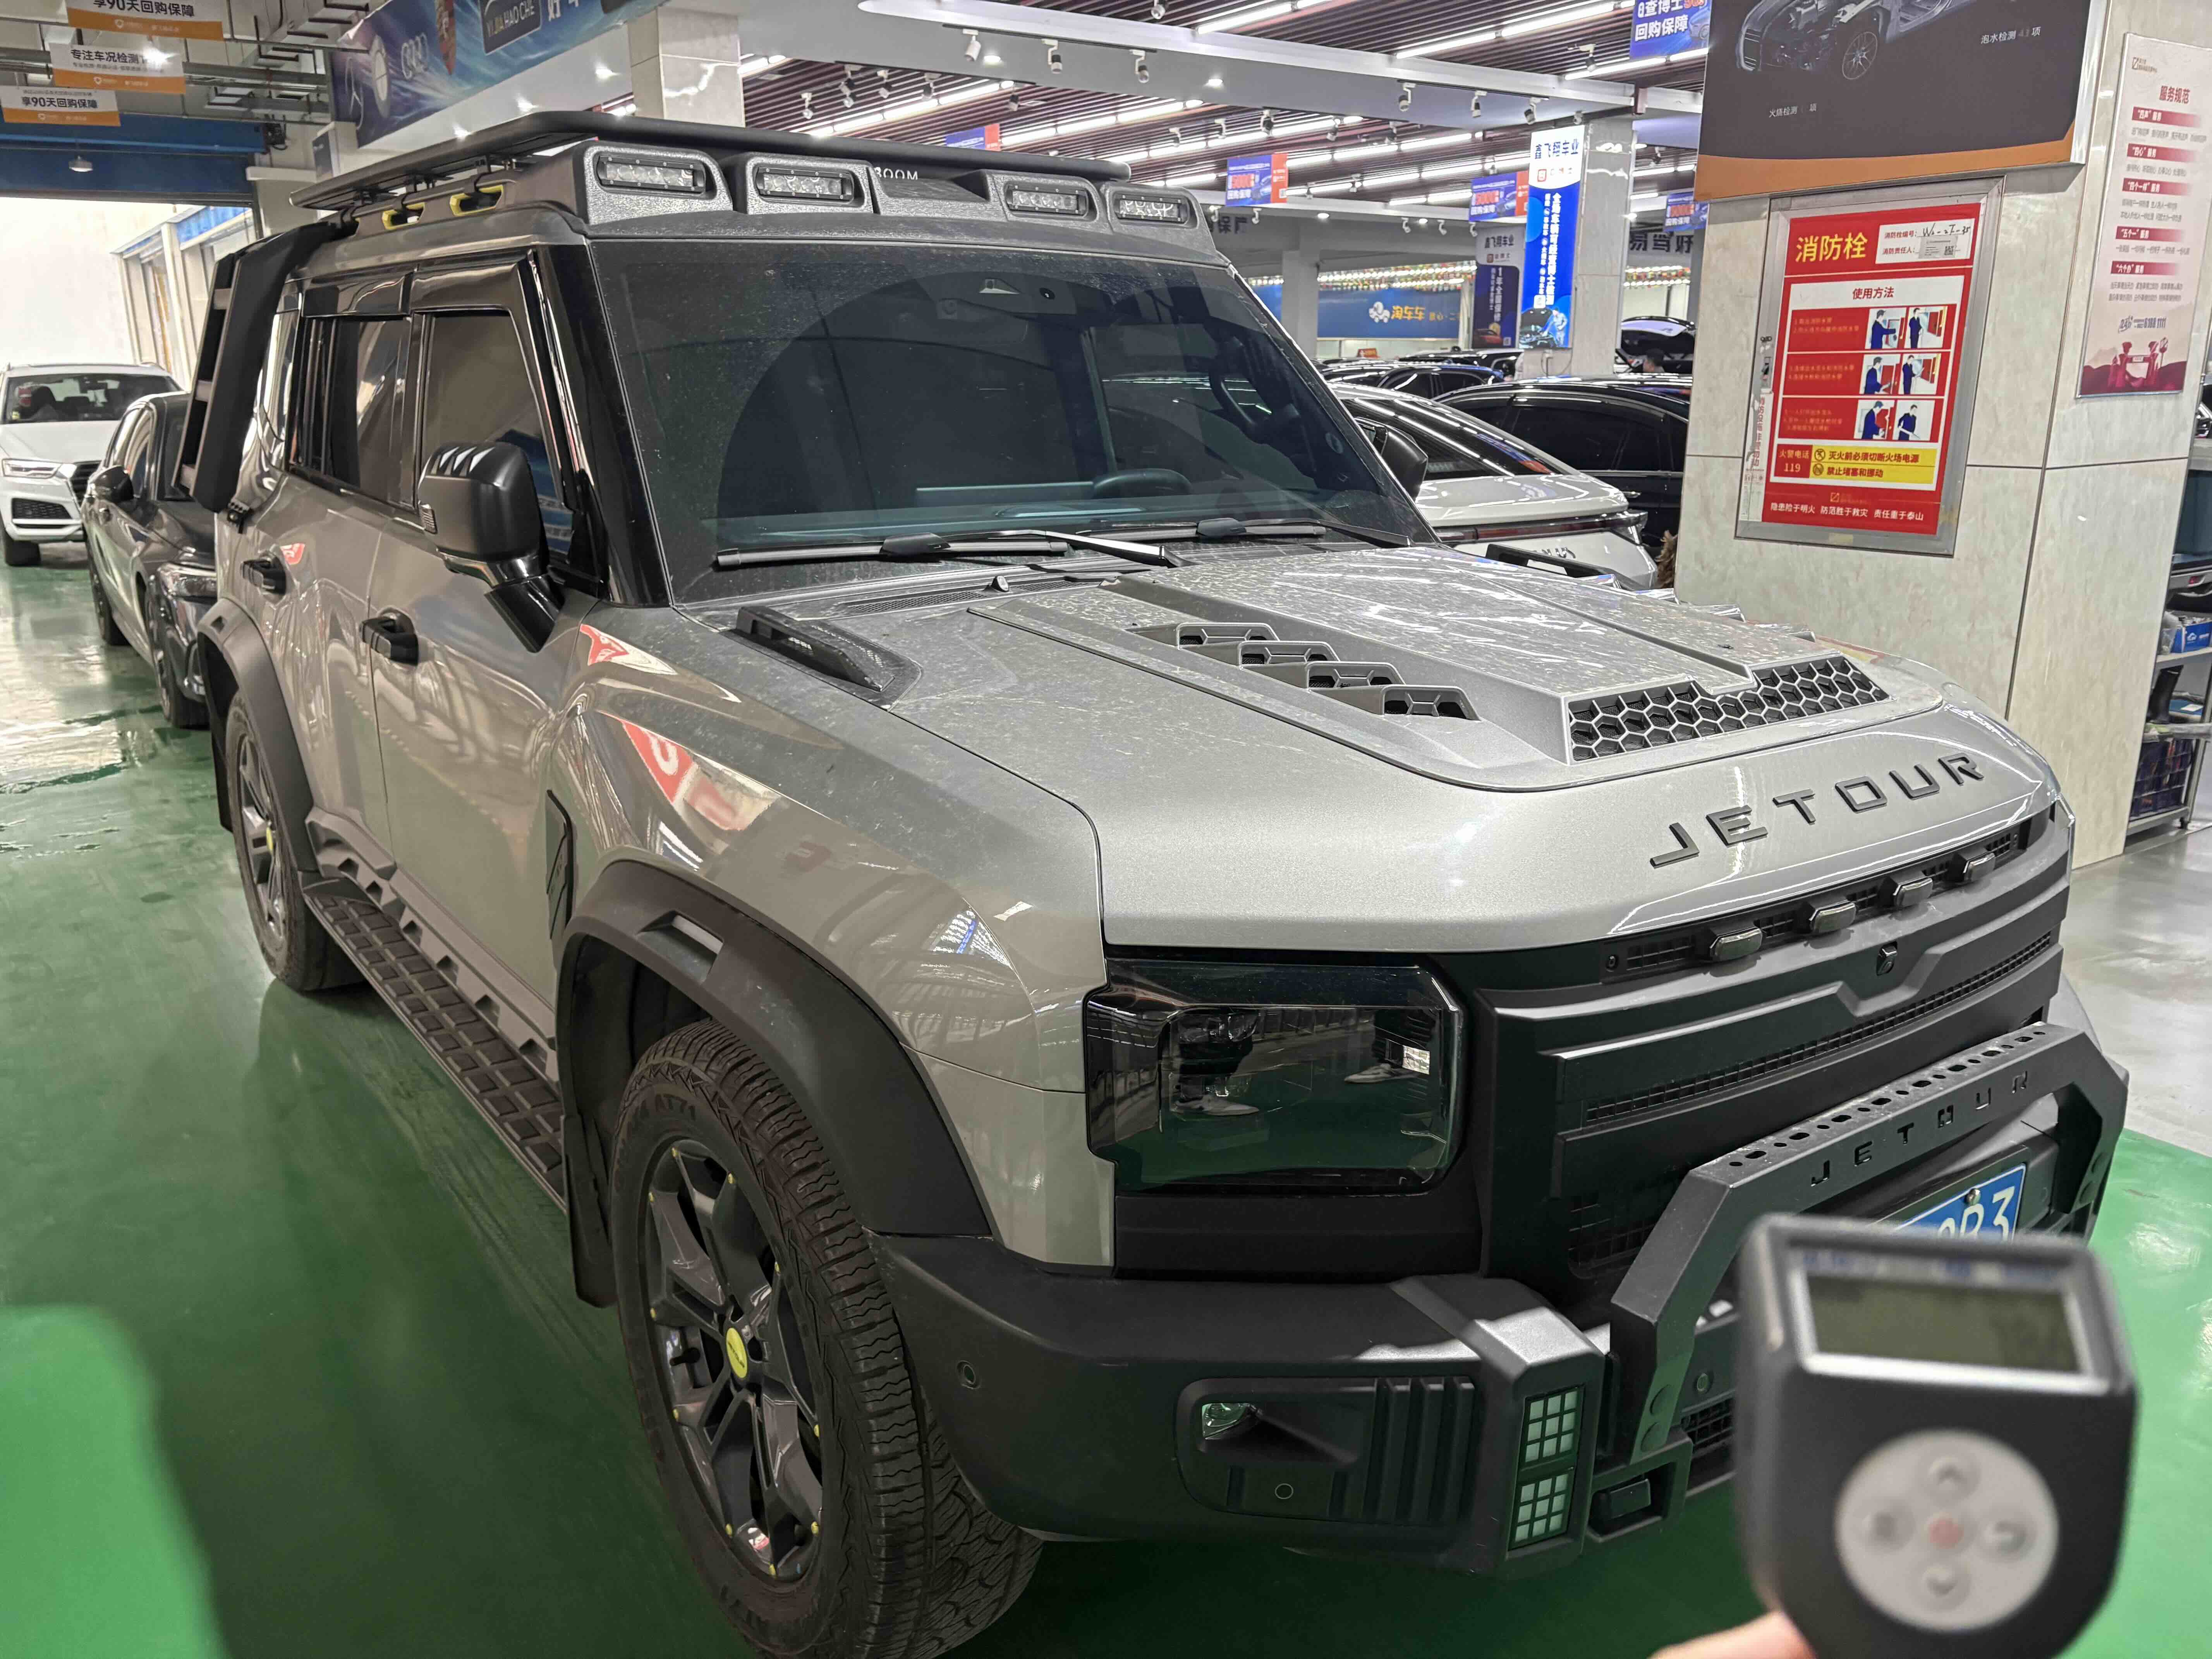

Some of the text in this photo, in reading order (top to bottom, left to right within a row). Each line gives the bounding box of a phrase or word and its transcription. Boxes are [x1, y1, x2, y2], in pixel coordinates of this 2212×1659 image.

[1635, 15, 1688, 41] 回购保障
[1981, 30, 2016, 43] 泡水检测
[2032, 26, 2041, 36] 项
[2159, 86, 2190, 104] 服务规范
[21, 97, 98, 109] 享90天回购保障
[1769, 106, 1797, 118] 火烧检测
[1795, 233, 1868, 263] 消防栓
[1853, 286, 1894, 300] 使用方法
[1391, 306, 1425, 320] 淘车车
[1779, 449, 1809, 459] 火警电话
[1829, 451, 1919, 463] 灭火前必须切断火场电源
[1784, 464, 1801, 472] 119
[1771, 502, 1924, 521] 隐患险于明火 防范胜于救灾 责任重于泰山
[1650, 752, 1984, 868] JETOUR
[1810, 1070, 2028, 1187] JETOUR
